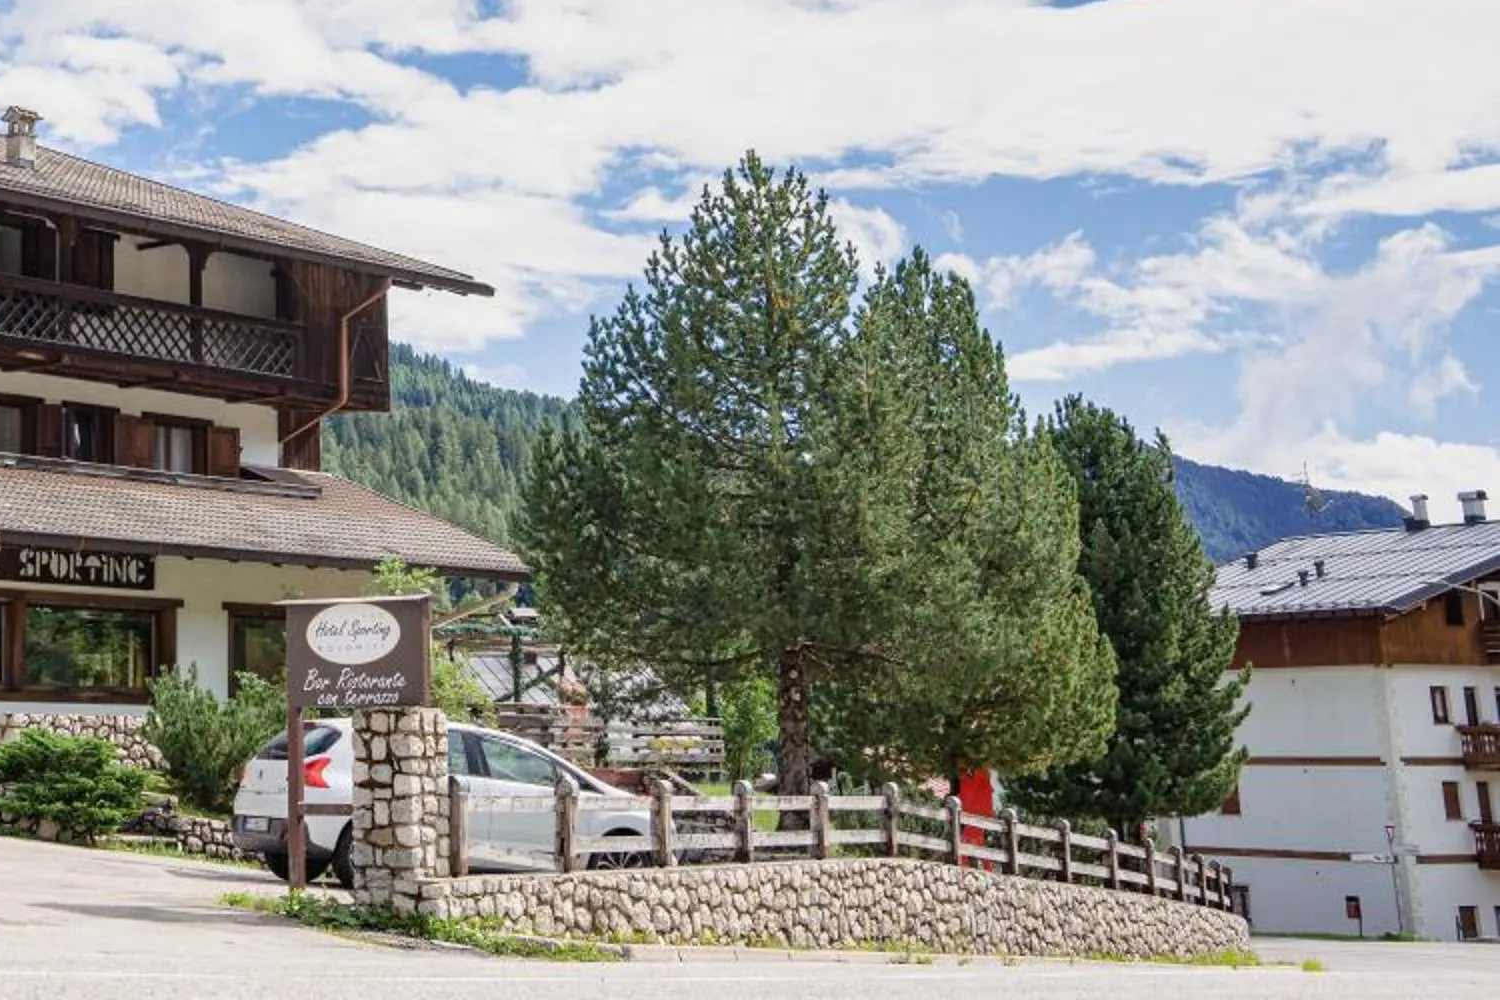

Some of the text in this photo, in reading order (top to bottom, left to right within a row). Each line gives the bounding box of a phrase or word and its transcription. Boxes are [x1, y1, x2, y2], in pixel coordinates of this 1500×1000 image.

[315, 619, 346, 637] Hotel
[303, 667, 406, 691] Bar Ristorante
